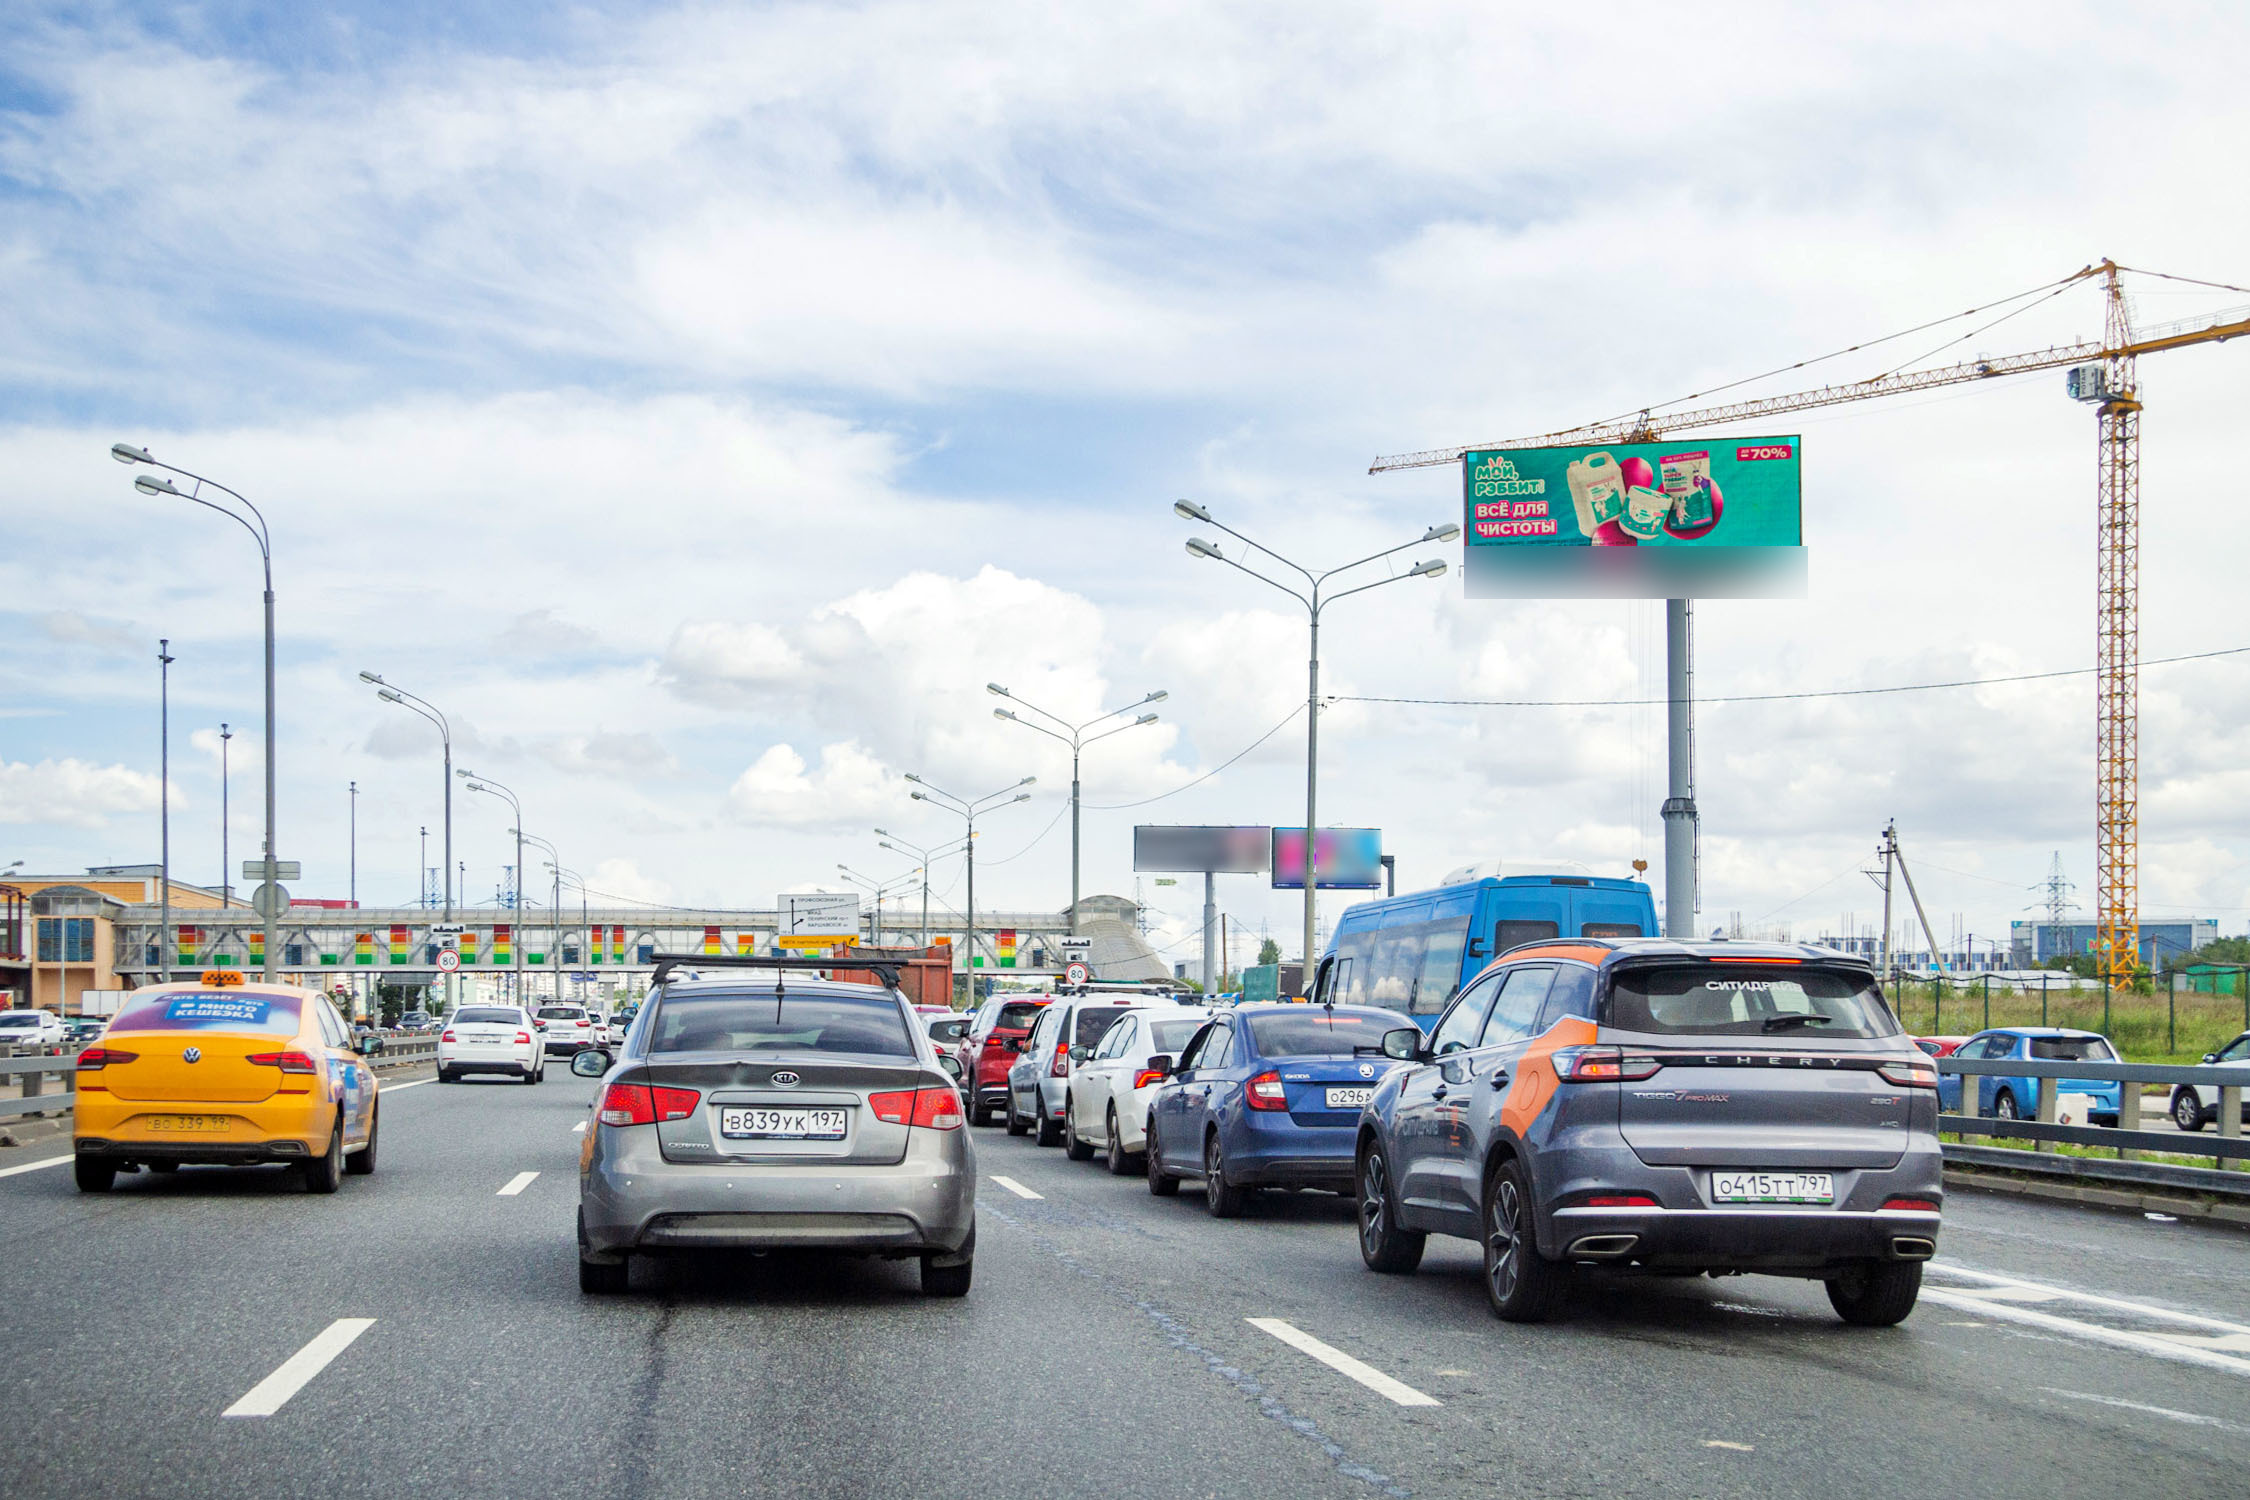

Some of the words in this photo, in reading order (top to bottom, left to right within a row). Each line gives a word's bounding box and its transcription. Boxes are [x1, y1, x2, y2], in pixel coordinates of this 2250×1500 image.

[1478, 502, 1509, 517] ВСЁ
[1513, 503, 1546, 518] ДЛЯ
[1478, 521, 1555, 535] ЧИСТОТЫ
[442, 957, 455, 966] 80
[1071, 970, 1082, 978] 80
[199, 1003, 257, 1012] МНОГО
[175, 1009, 255, 1019] КЕШБЭКА
[1704, 1056, 1842, 1067] CHERY
[777, 1074, 795, 1082] KIA
[177, 1117, 203, 1128] 339
[731, 1112, 805, 1130] В839УК
[811, 1112, 840, 1126] 197
[1721, 1175, 1794, 1194] О415ТТ
[1799, 1175, 1828, 1190] 797
